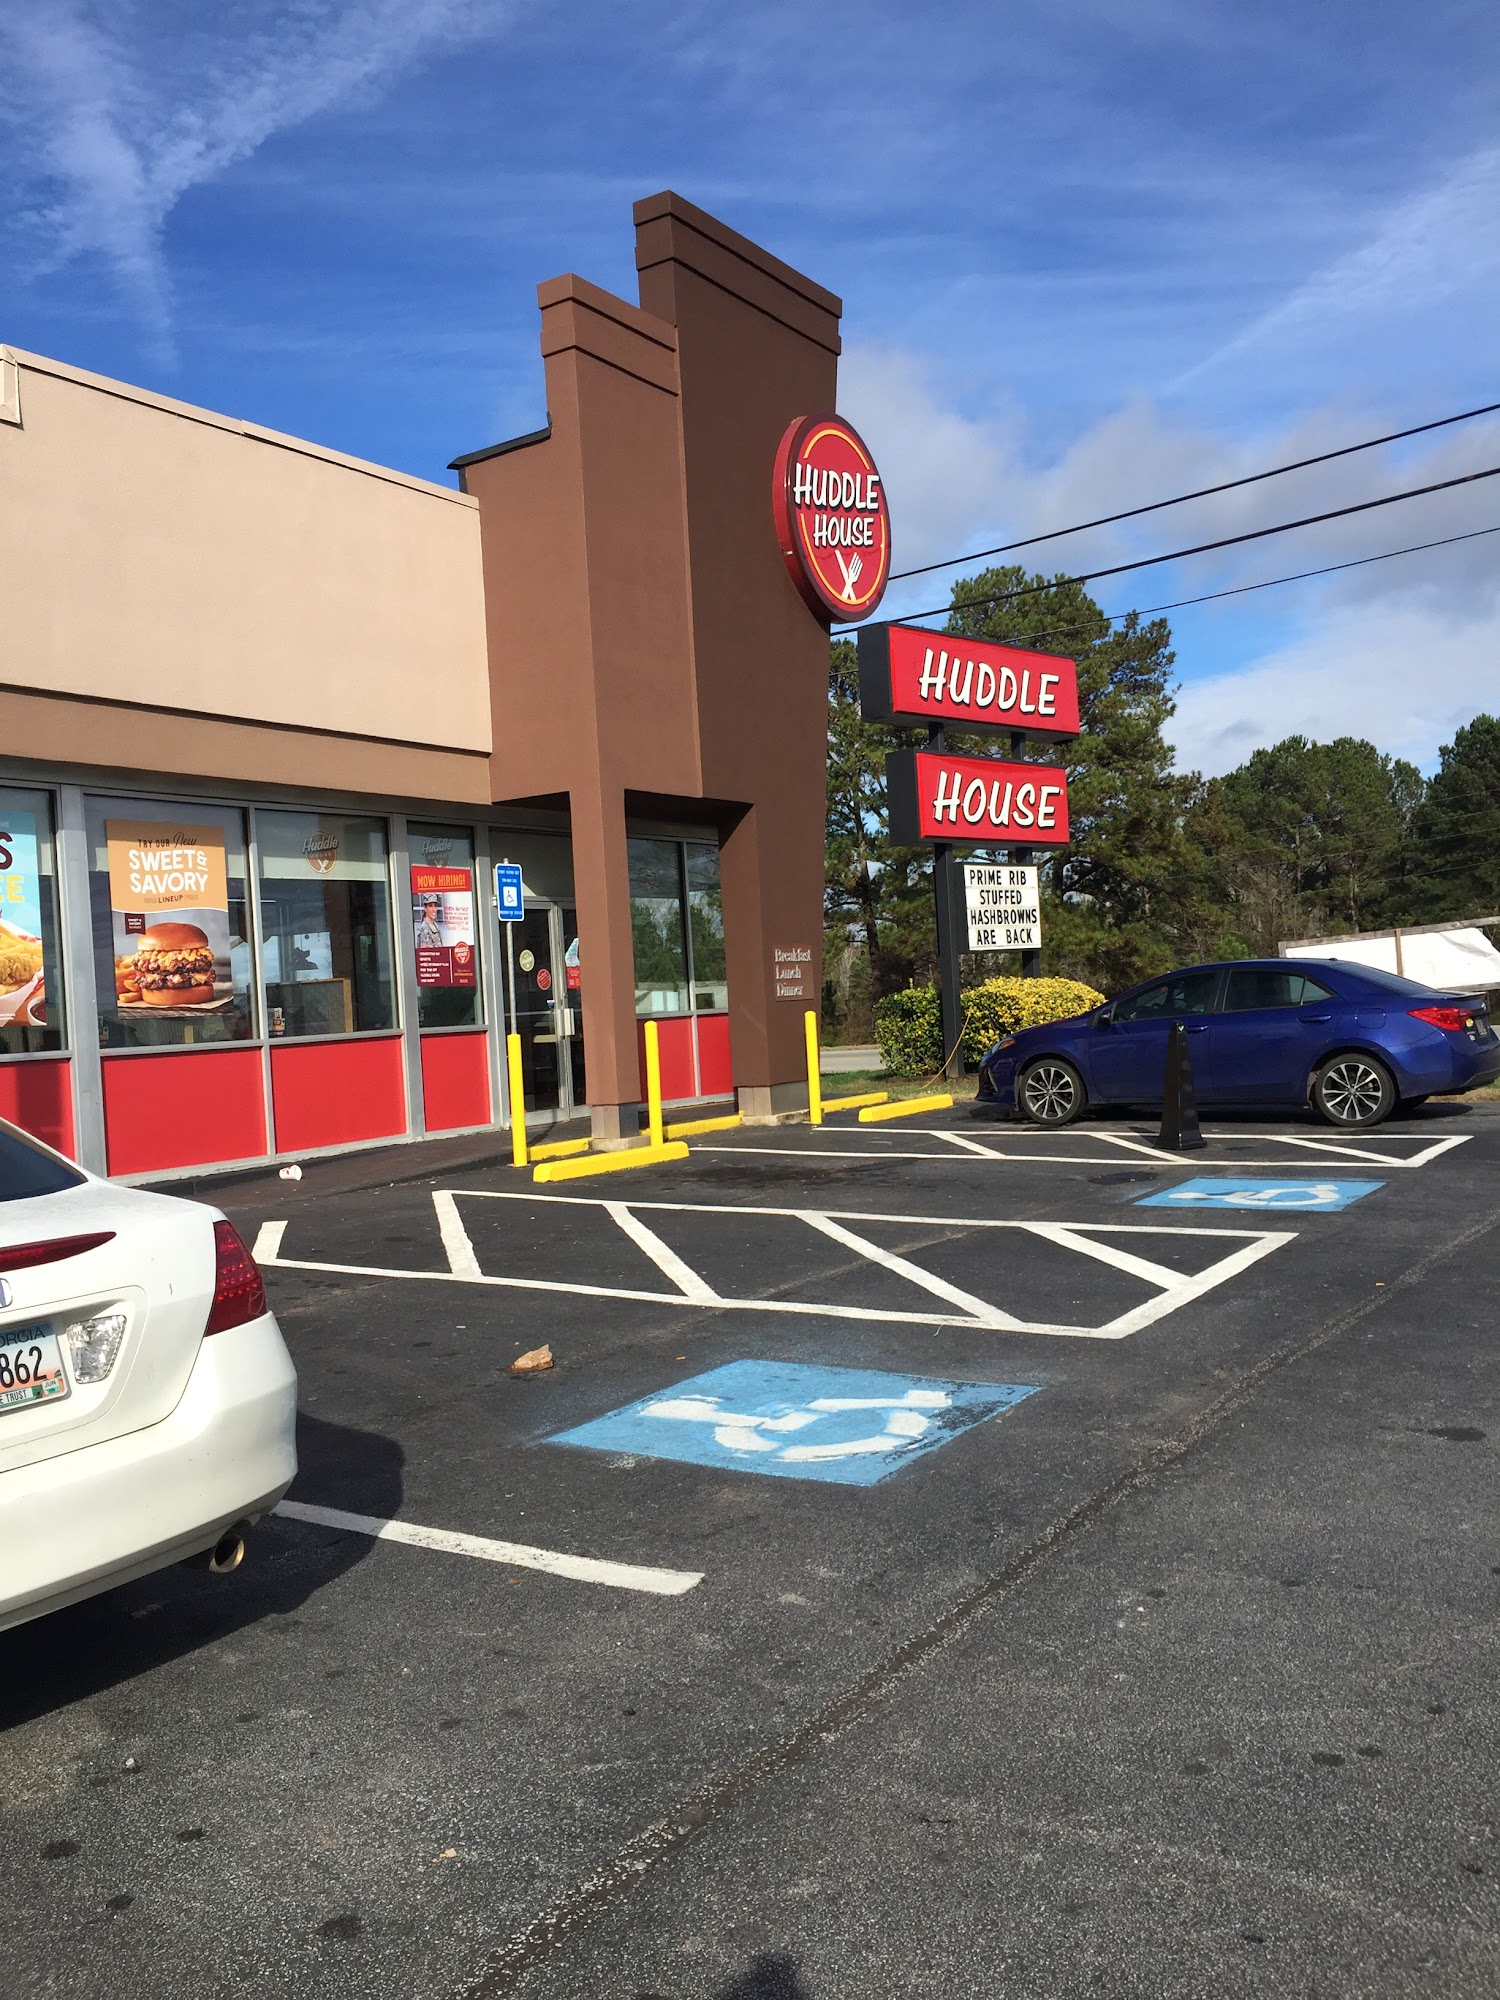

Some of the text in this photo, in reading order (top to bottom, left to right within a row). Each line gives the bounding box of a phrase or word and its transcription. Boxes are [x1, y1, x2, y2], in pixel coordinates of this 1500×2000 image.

[793, 462, 880, 510] HUDDLE
[813, 513, 874, 547] HOUSE
[918, 648, 1059, 715] HUDDLE
[933, 770, 1060, 828] HOUSE
[137, 831, 197, 848] TRY OUR New
[302, 834, 339, 853] Huddle
[130, 872, 208, 894] SAVORY
[417, 873, 466, 887] NOW HIRING!
[969, 869, 1027, 885] PRIME RIB
[158, 894, 184, 904] LINEUP
[979, 889, 1022, 905] STUFFED
[970, 908, 1037, 926] HASHBROWNS
[976, 928, 1033, 945] ARE BACK
[774, 948, 811, 962] Breakfast
[775, 964, 802, 979] Lunch
[776, 982, 803, 997] Dinner
[6, 1389, 28, 1402] TRUST
